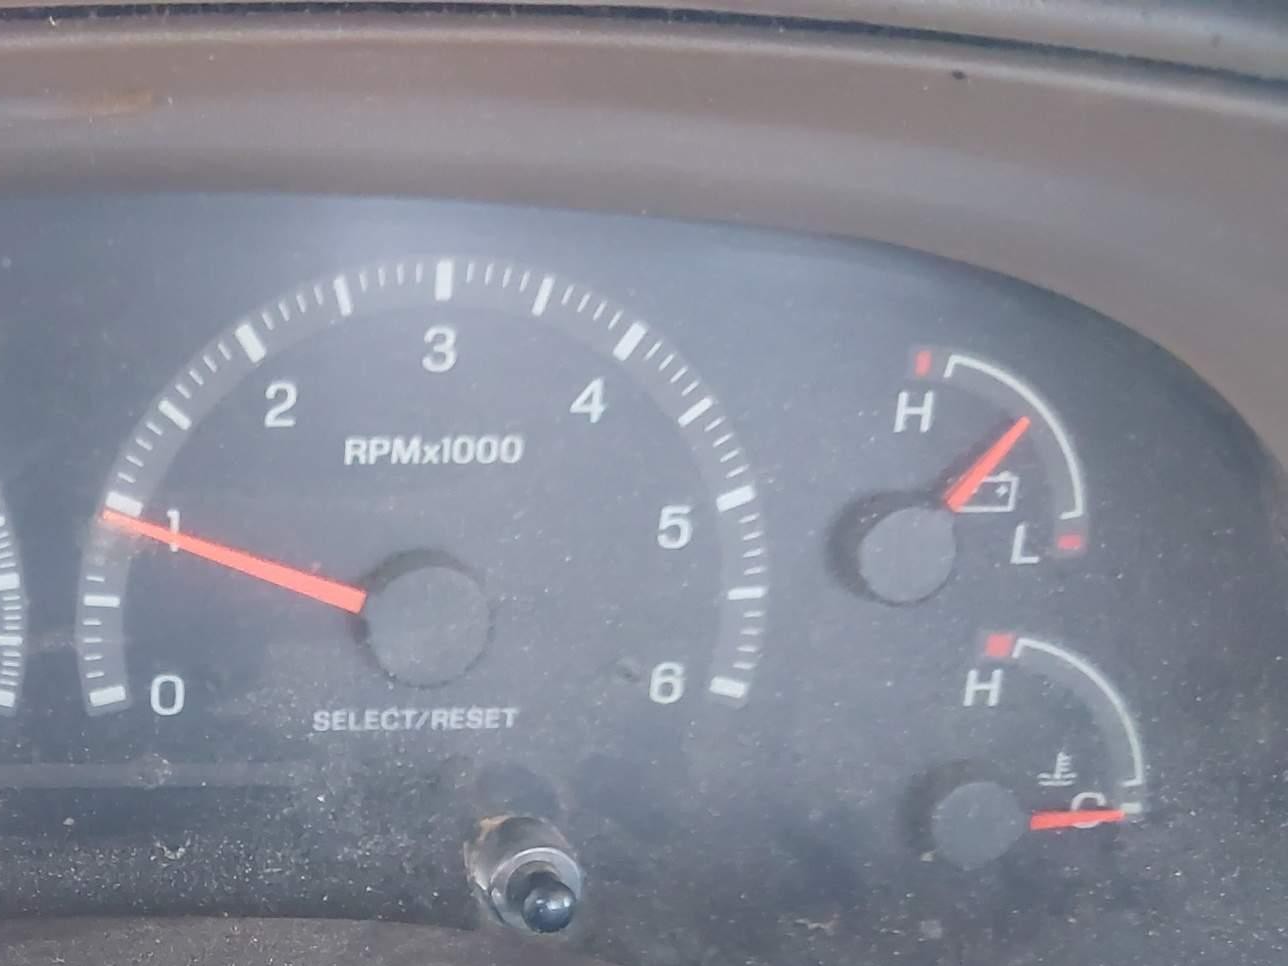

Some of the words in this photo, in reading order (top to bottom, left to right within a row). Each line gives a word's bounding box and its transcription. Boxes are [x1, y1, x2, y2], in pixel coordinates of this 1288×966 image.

[421, 325, 457, 372] 3
[263, 382, 298, 428] 2
[569, 378, 606, 423] 4
[893, 391, 935, 433] H
[343, 436, 525, 467] RPMx1000
[164, 509, 182, 552] 1
[656, 505, 693, 550] 5
[1011, 523, 1040, 564] L
[149, 676, 186, 717] 0
[648, 661, 685, 705] 6
[962, 669, 1003, 706] H
[312, 709, 518, 734] SELECT/RESET
